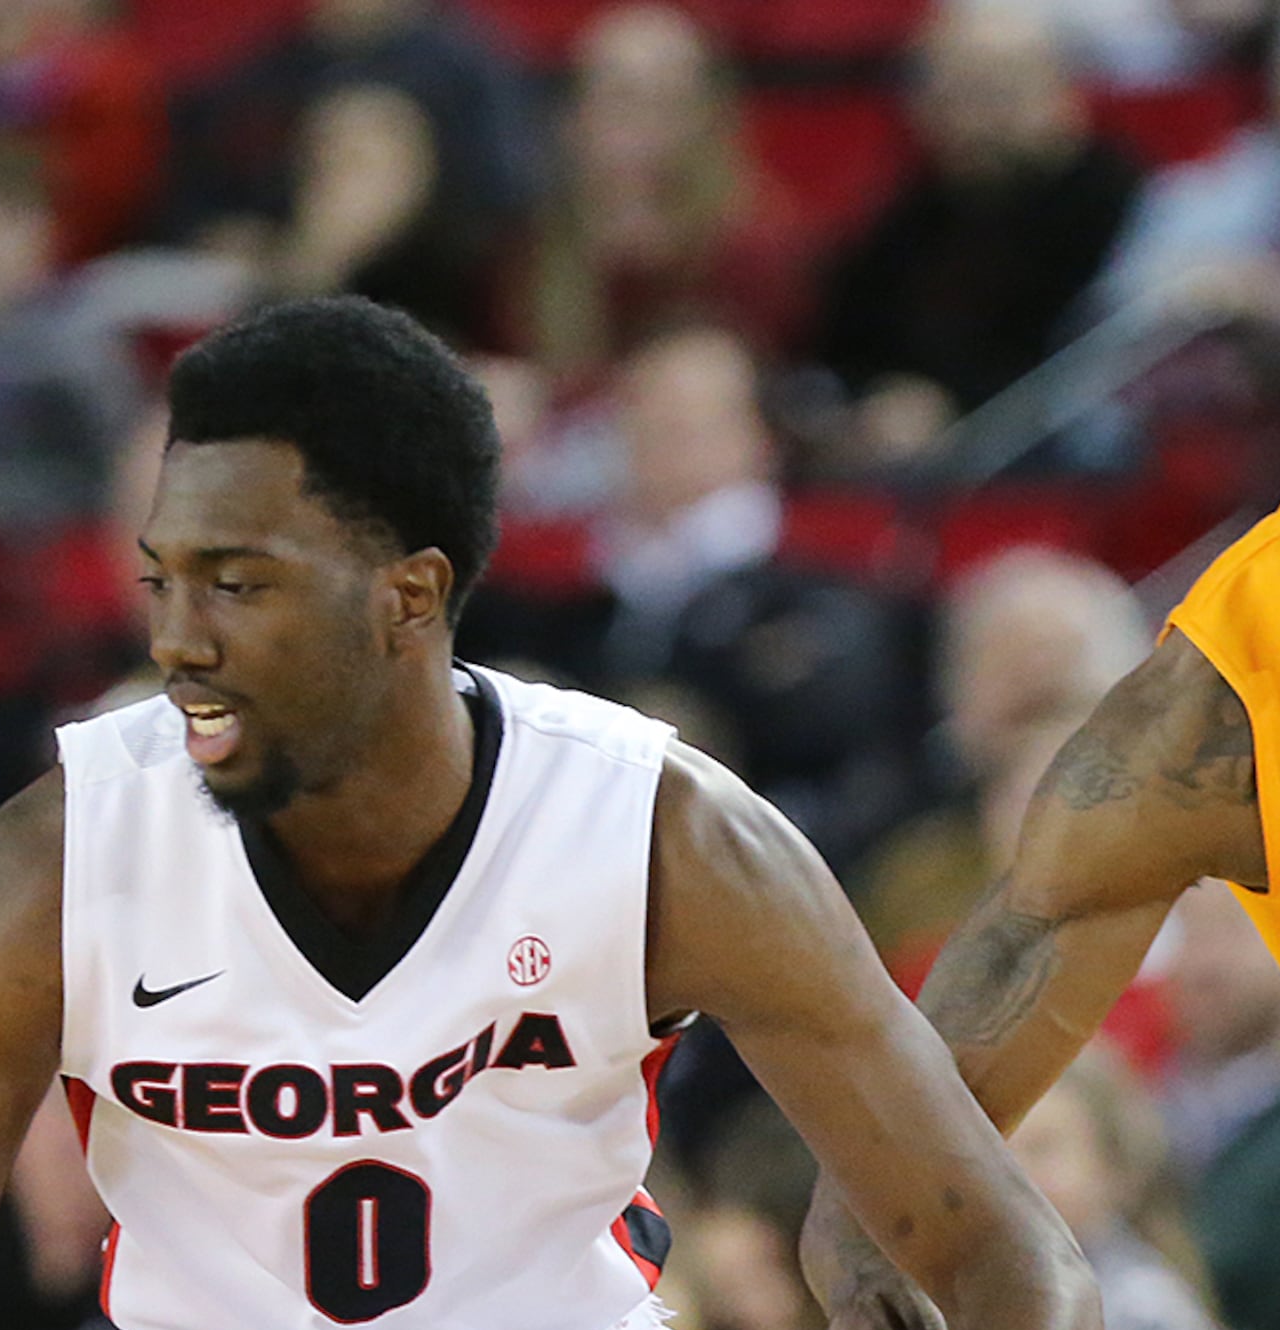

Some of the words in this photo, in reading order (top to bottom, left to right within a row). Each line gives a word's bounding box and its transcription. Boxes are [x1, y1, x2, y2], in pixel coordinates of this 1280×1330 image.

[508, 937, 550, 984] SEC
[111, 1012, 576, 1139] GEORGIA
[304, 1159, 432, 1324] 0
